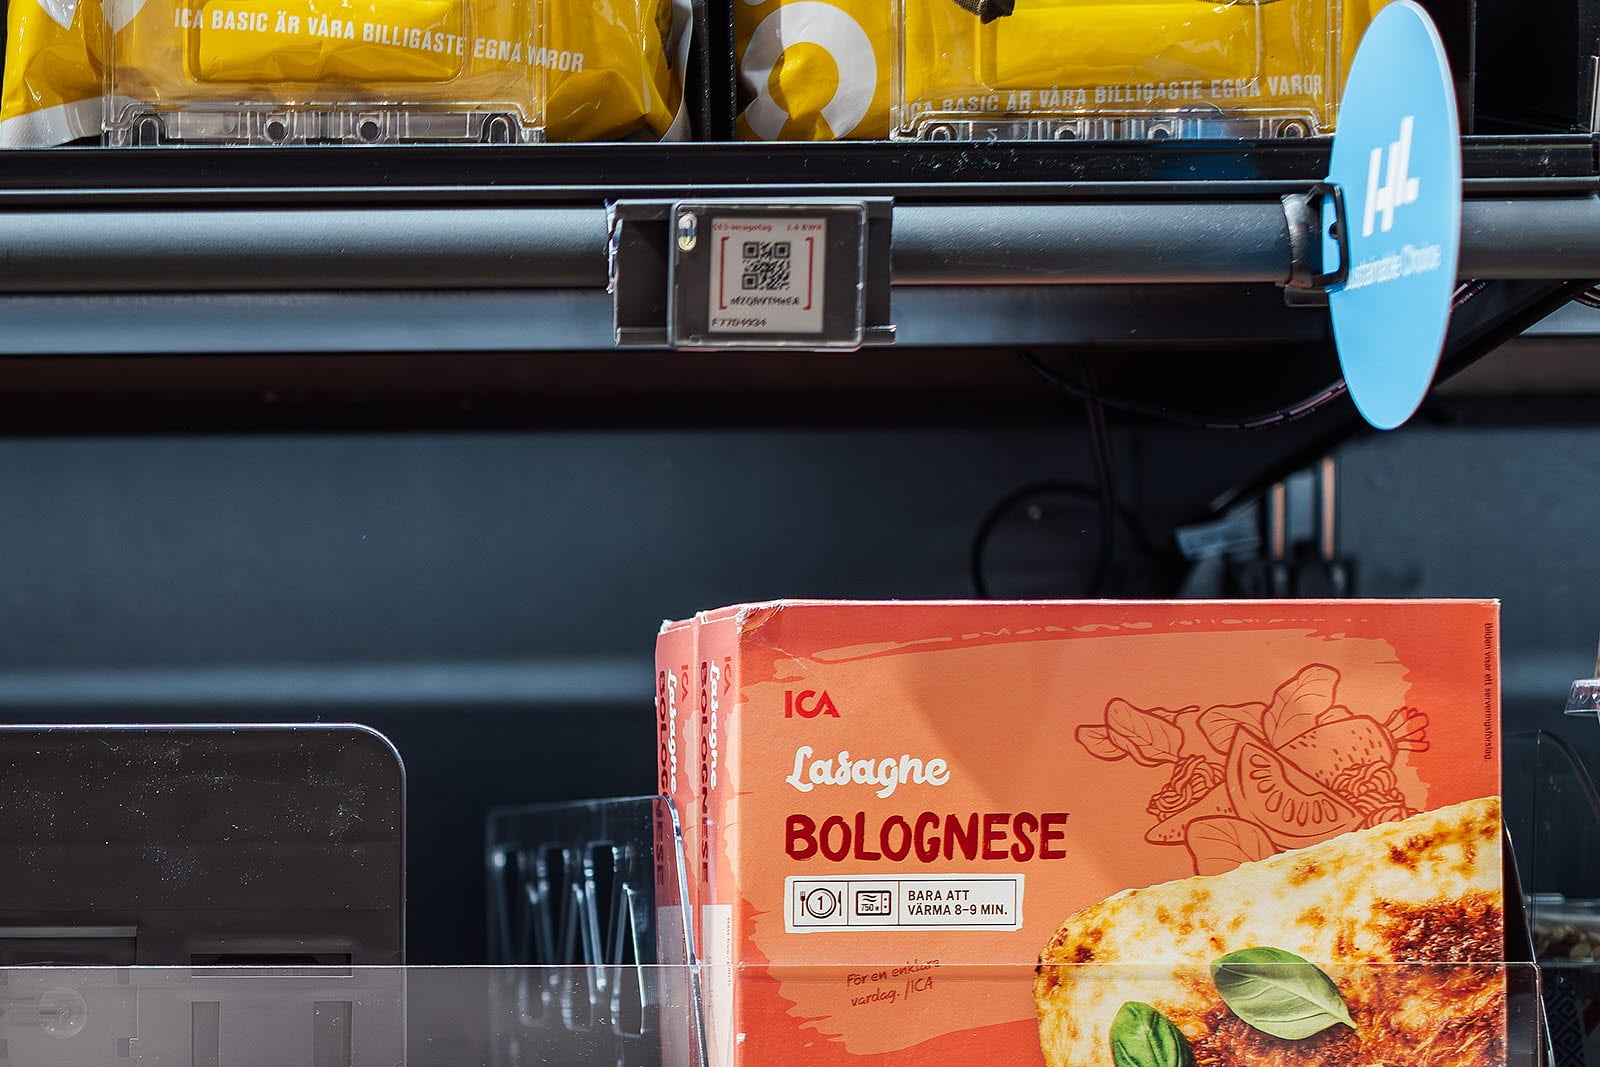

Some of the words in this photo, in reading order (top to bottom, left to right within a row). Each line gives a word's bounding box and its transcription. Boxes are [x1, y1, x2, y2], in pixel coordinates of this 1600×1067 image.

[174, 8, 203, 28] ICA
[211, 9, 268, 31] BASIC
[274, 9, 300, 34] ÄR
[307, 15, 355, 41] VÅRA
[362, 23, 466, 56] BILLIGASTE
[473, 37, 522, 63] EGNA
[527, 46, 584, 73] VAROR
[942, 93, 999, 114] BASIC
[1006, 89, 1032, 111] ÄR
[1095, 79, 1203, 104] BILLIGASTE
[1211, 77, 1260, 99] EGNA
[1268, 73, 1323, 97] VAROR
[724, 656, 732, 697] ICA
[784, 689, 841, 719] ICA
[708, 660, 721, 792] Lasagne
[700, 661, 709, 884] BOLOGNESE
[785, 745, 951, 799] Lasagne
[785, 811, 1070, 864] BOLOGNESE
[907, 902, 952, 916] VÄRMA
[980, 904, 1008, 916] MIN.
[908, 890, 943, 901] BARA
[946, 890, 970, 901] ATT
[846, 972, 867, 988] För
[870, 970, 887, 983] en
[850, 989, 900, 1007] vardag.
